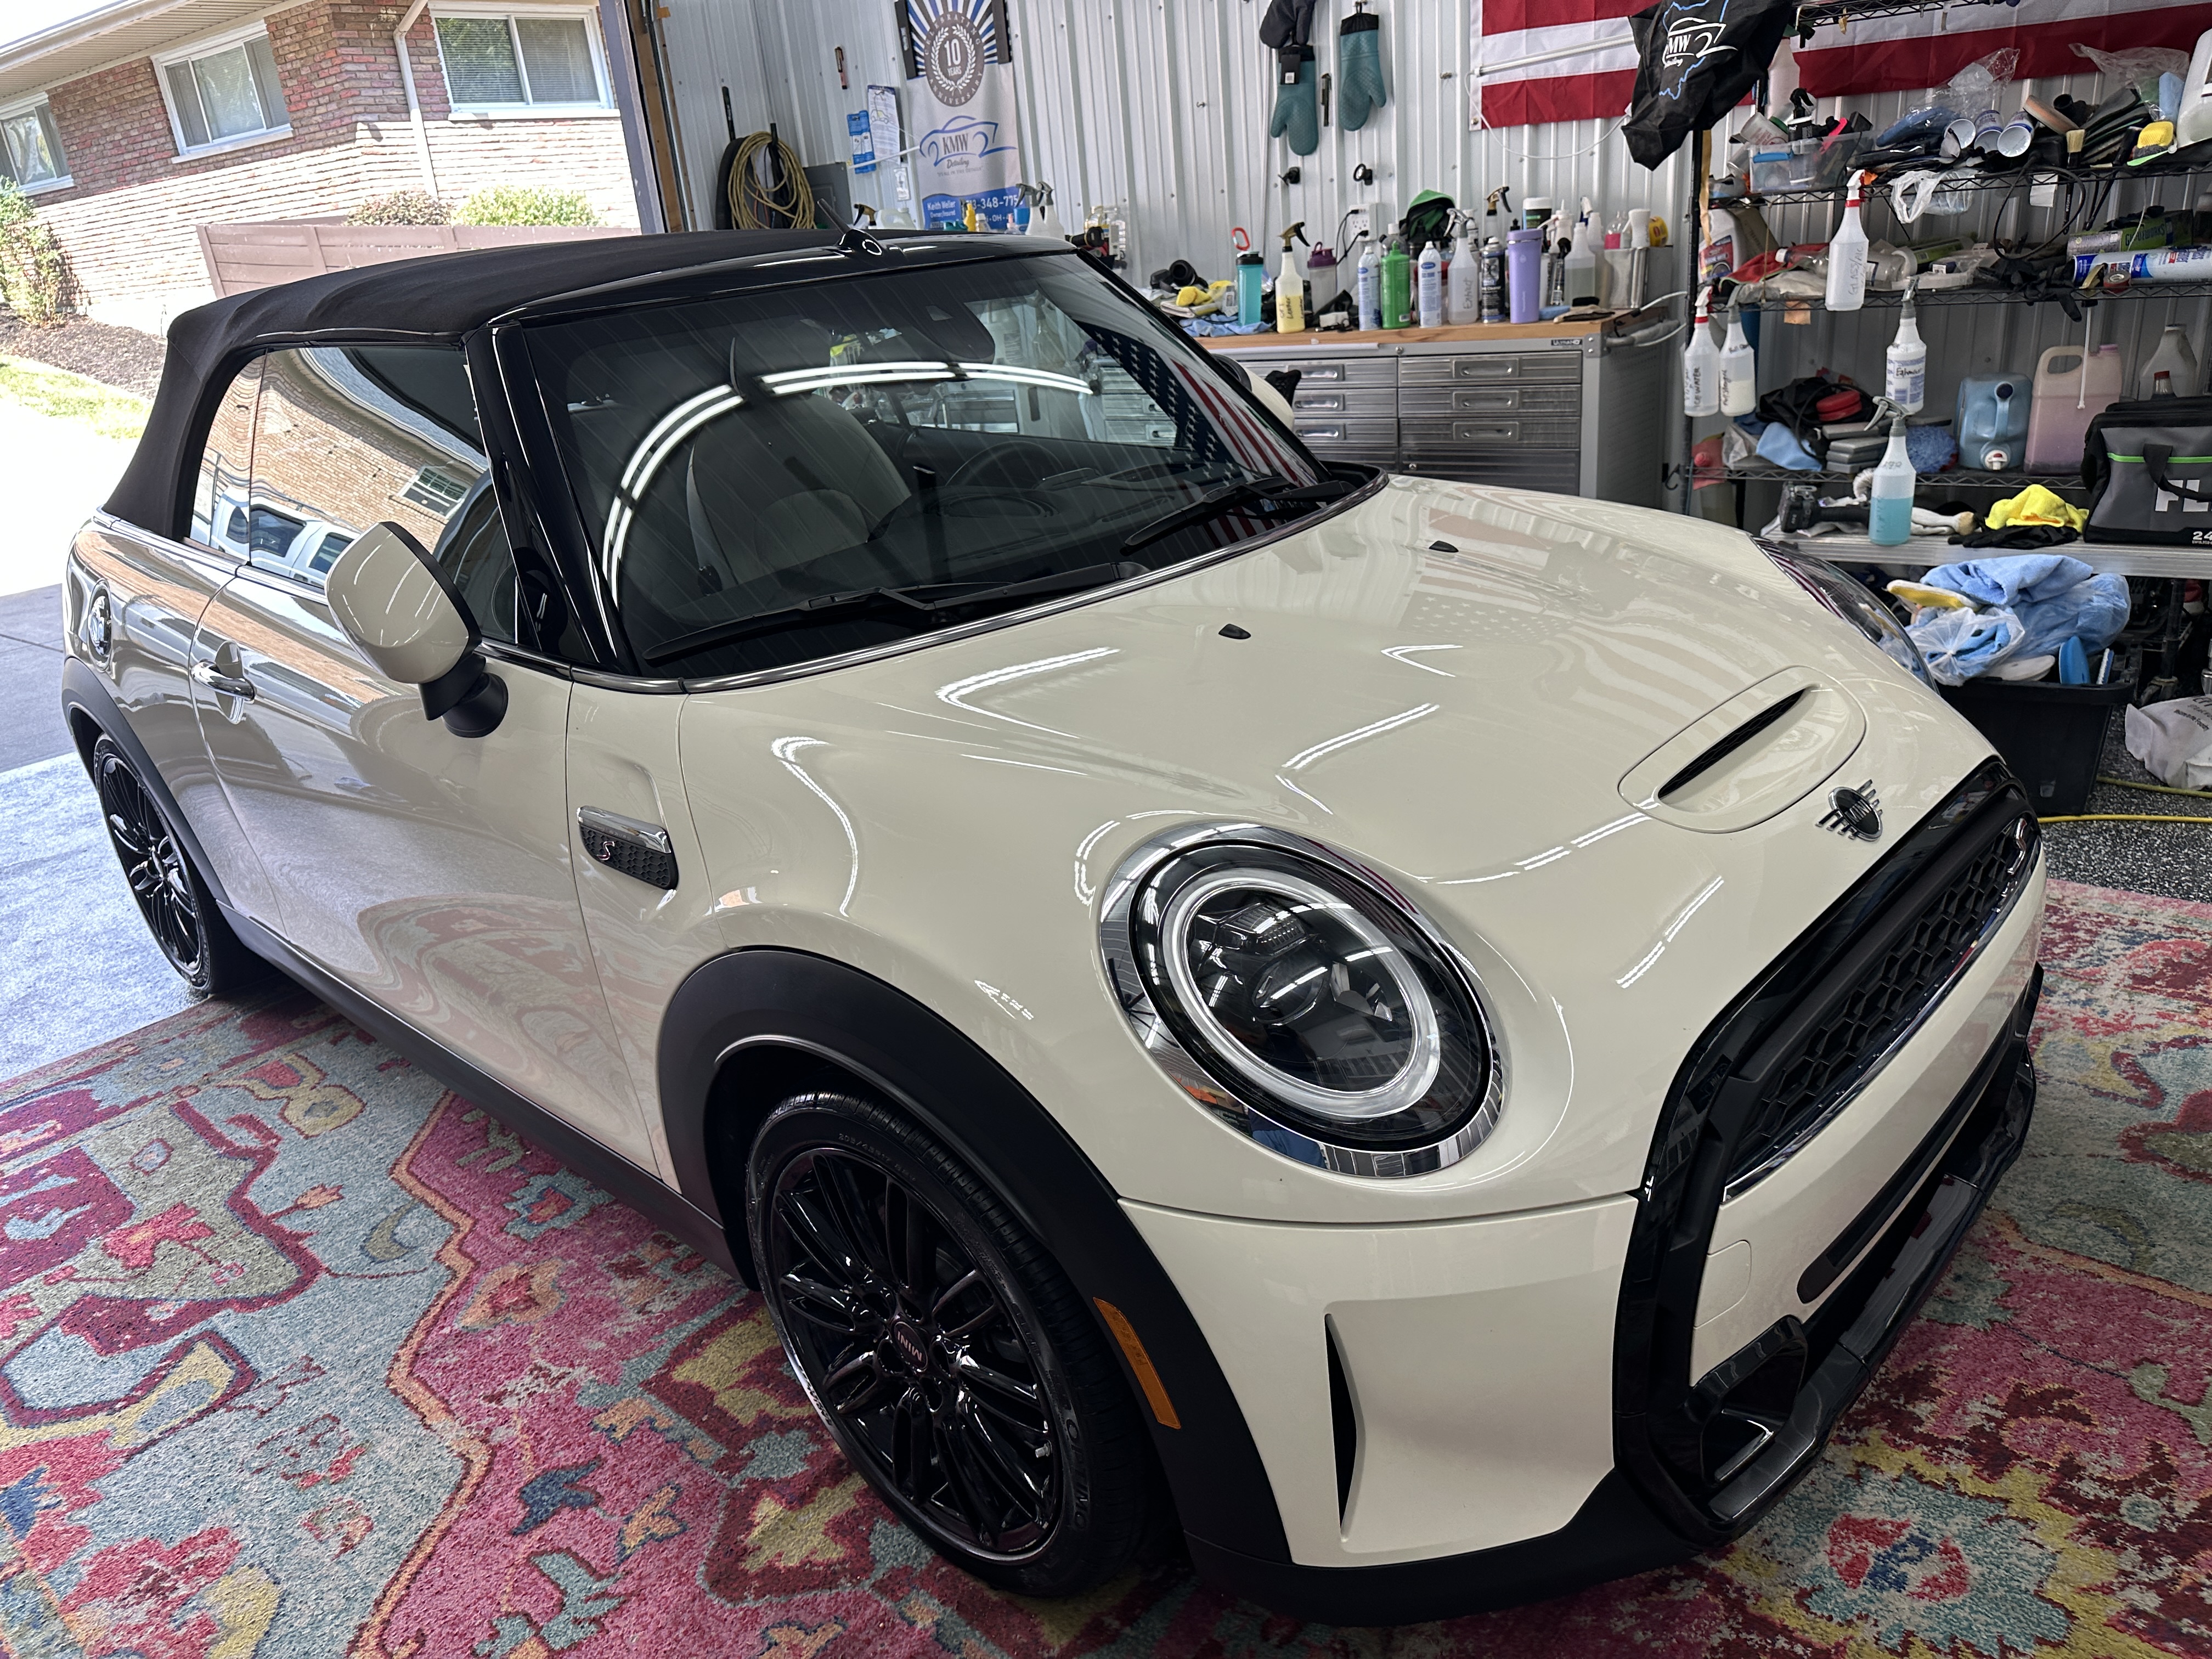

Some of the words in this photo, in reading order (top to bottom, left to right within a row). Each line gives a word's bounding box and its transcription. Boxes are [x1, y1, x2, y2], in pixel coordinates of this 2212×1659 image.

[944, 38, 961, 66] 10
[947, 66, 962, 77] YEARS
[929, 72, 983, 105] ANNIVERSARY
[943, 133, 968, 155] KMW
[947, 156, 969, 169] Detailing
[1692, 367, 1702, 394] WATER
[2155, 479, 2212, 512] FL
[1844, 799, 1872, 825] MINI
[596, 841, 615, 861] S
[897, 1331, 923, 1362] MINI
